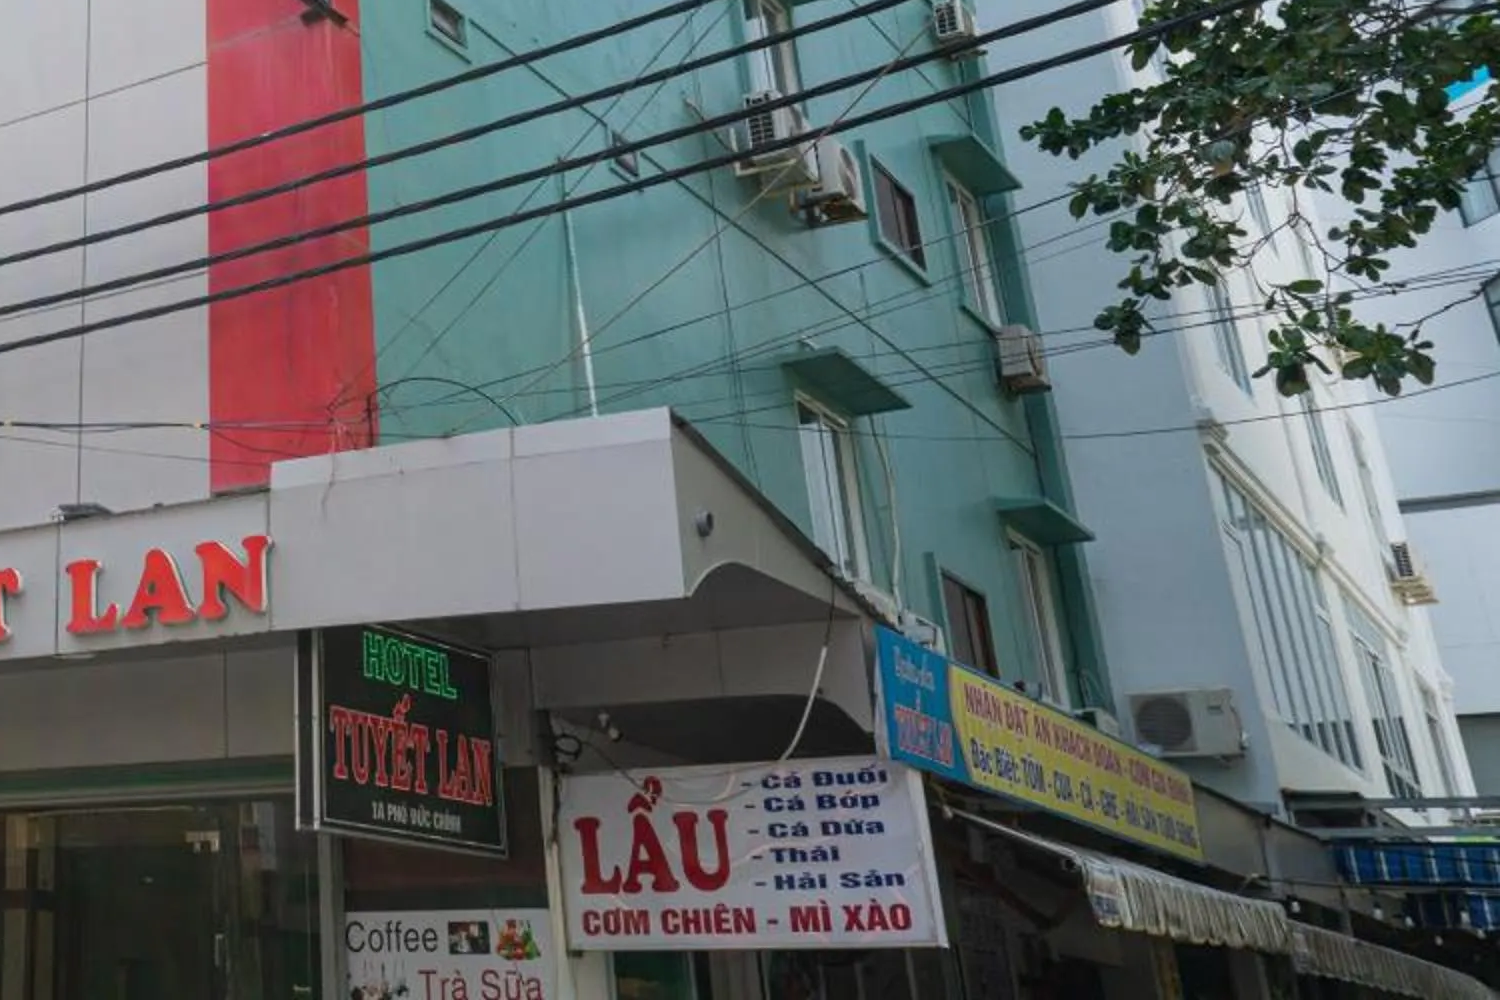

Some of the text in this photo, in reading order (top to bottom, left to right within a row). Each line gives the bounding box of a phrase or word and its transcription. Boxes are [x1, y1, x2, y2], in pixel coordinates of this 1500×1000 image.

[65, 535, 273, 637] LAN
[362, 630, 458, 700] HOTEL
[329, 692, 493, 808] TUYẾT LAN
[761, 770, 802, 790] Cá
[763, 794, 806, 813] Cá
[573, 775, 731, 895] LẨU
[767, 820, 809, 839] Cá
[770, 844, 841, 864] Thái
[774, 871, 827, 891] Hải
[582, 905, 650, 937] CƠM
[660, 902, 757, 936] CHIÊN
[789, 899, 832, 933] MÌ
[843, 898, 913, 933] XÀO
[345, 920, 439, 953] Coffee
[418, 968, 469, 1000] Trà
